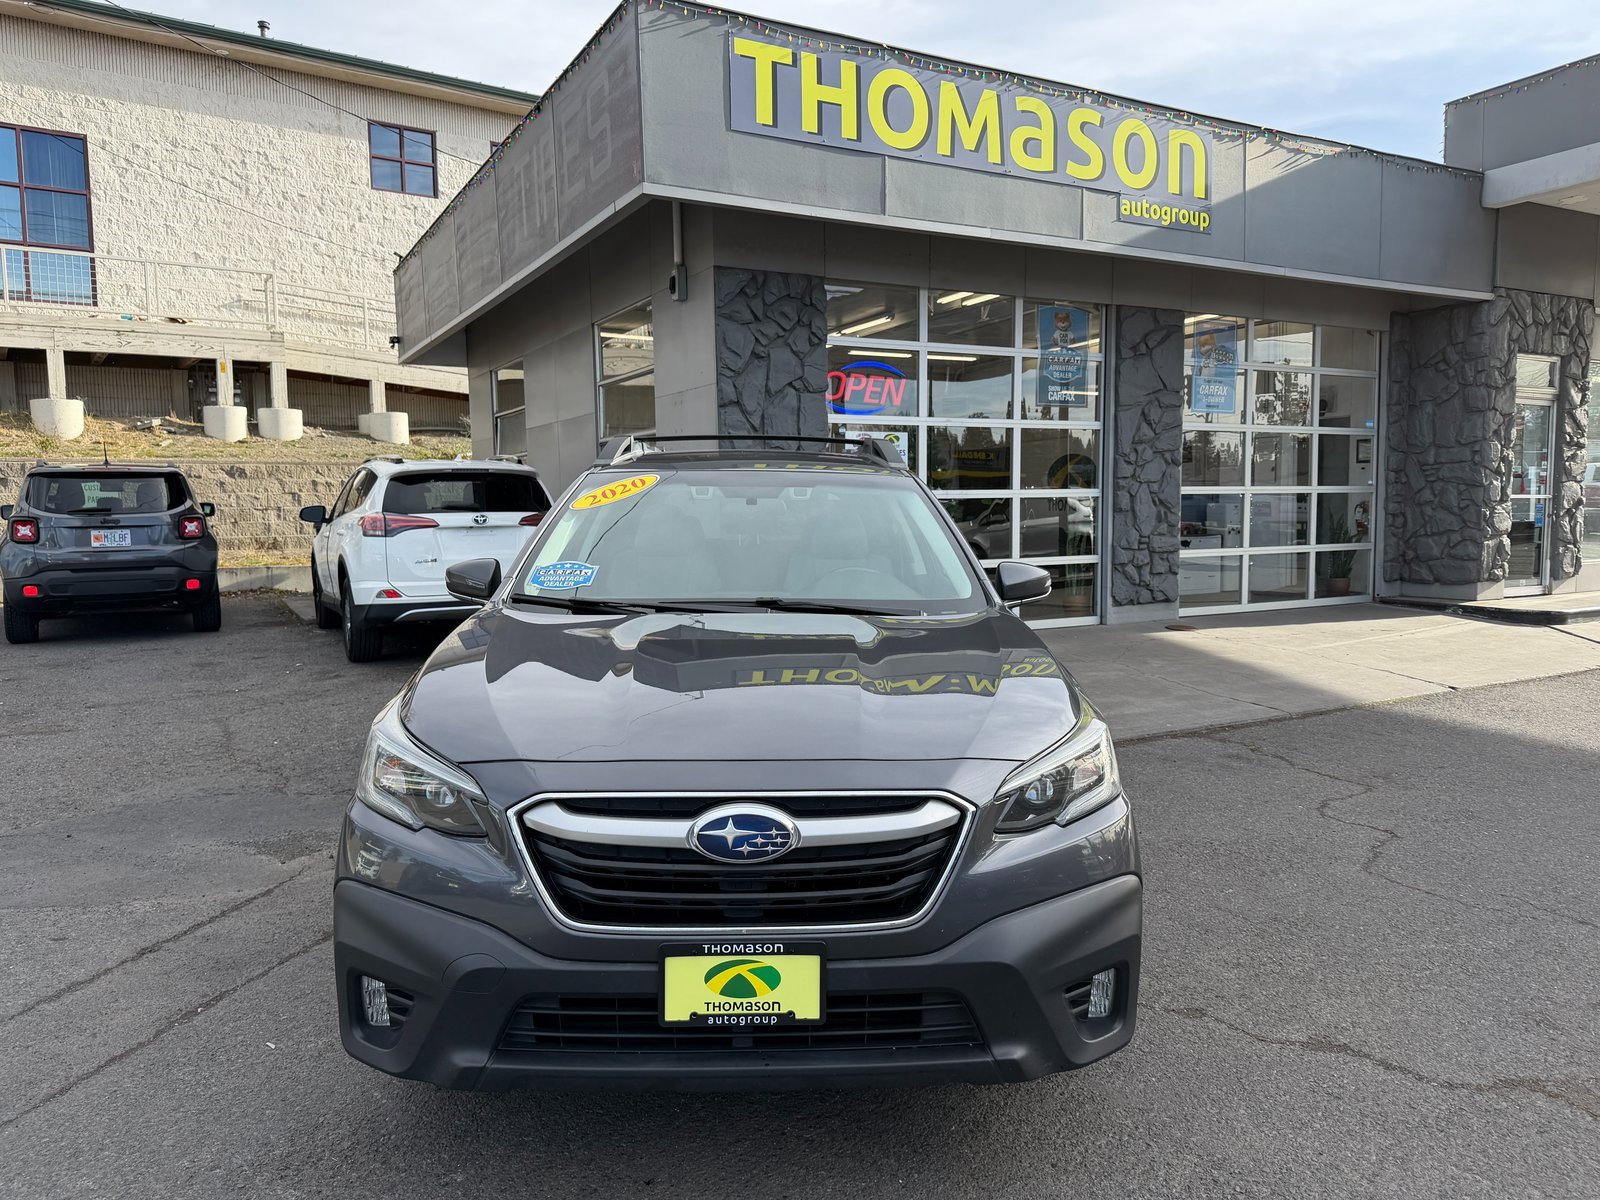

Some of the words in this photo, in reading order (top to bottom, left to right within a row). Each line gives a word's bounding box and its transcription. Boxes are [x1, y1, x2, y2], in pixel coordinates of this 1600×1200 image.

[733, 37, 1207, 200] THOMason
[1120, 196, 1210, 229] autogroup
[1048, 355, 1081, 364] CARFAX
[1049, 364, 1077, 372] ADVANTAGE
[1053, 371, 1072, 379] DEALER
[825, 371, 907, 407] OPEN
[1200, 384, 1228, 396] CARFAX
[1048, 391, 1075, 401] CARFAX
[585, 478, 646, 506] 2020
[538, 568, 592, 576] CARFAX
[702, 943, 785, 954] THOMason
[704, 1001, 781, 1012] THOMason
[707, 1015, 778, 1026] autogroup
